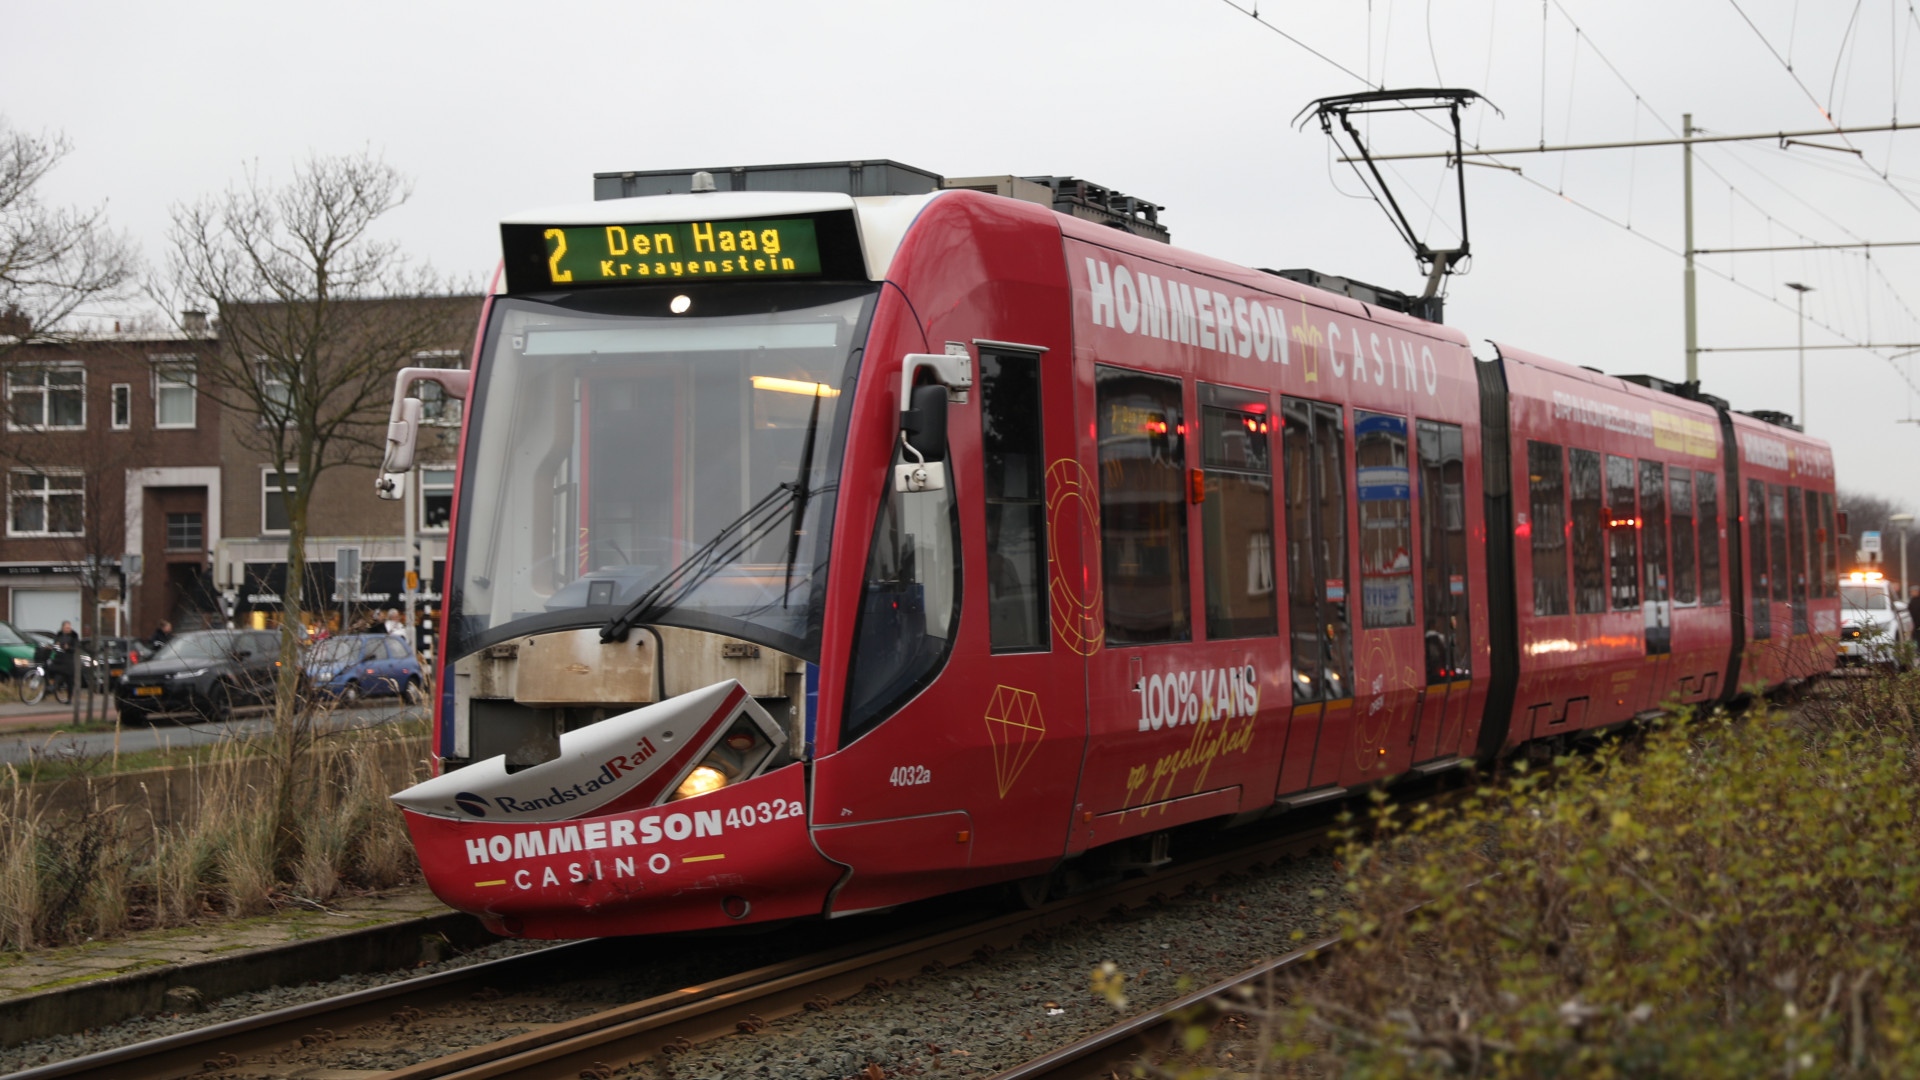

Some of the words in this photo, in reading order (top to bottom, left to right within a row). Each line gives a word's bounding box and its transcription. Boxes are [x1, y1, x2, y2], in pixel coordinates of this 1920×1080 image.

[544, 228, 573, 283] 2
[606, 225, 675, 257] Den
[692, 222, 781, 254] Haag
[600, 253, 796, 277] Kraayenstein
[1085, 257, 1290, 365] HOMMERSON
[1328, 321, 1437, 397] CASINO
[1138, 670, 1199, 732] 100%
[1201, 664, 1258, 723] KANS
[495, 736, 658, 814] RandstadRail
[889, 765, 932, 788] 4032a
[1119, 763, 1148, 825] op
[465, 809, 723, 865] HOMMERSON
[725, 799, 804, 829] 4032a
[514, 852, 672, 890] CASINO
